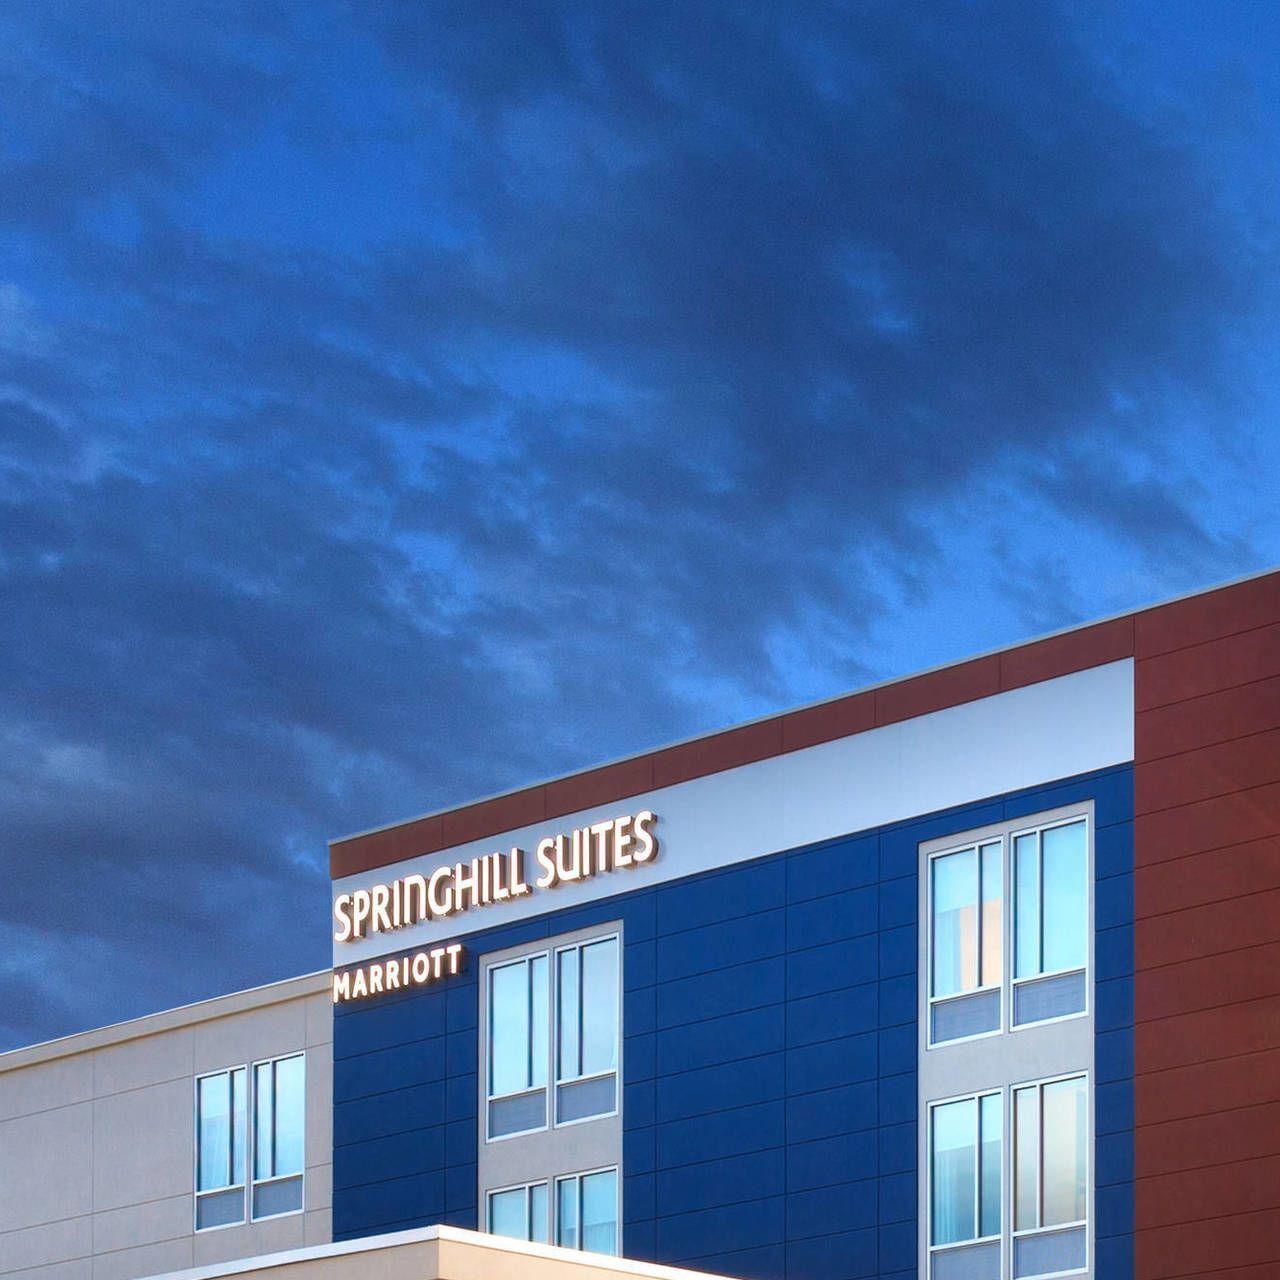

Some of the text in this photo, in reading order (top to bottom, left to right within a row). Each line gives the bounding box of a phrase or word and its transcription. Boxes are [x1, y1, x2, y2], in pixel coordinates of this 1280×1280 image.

[332, 810, 657, 944] SPRINGHILL SUITES
[332, 944, 463, 1003] MARRIOTT
